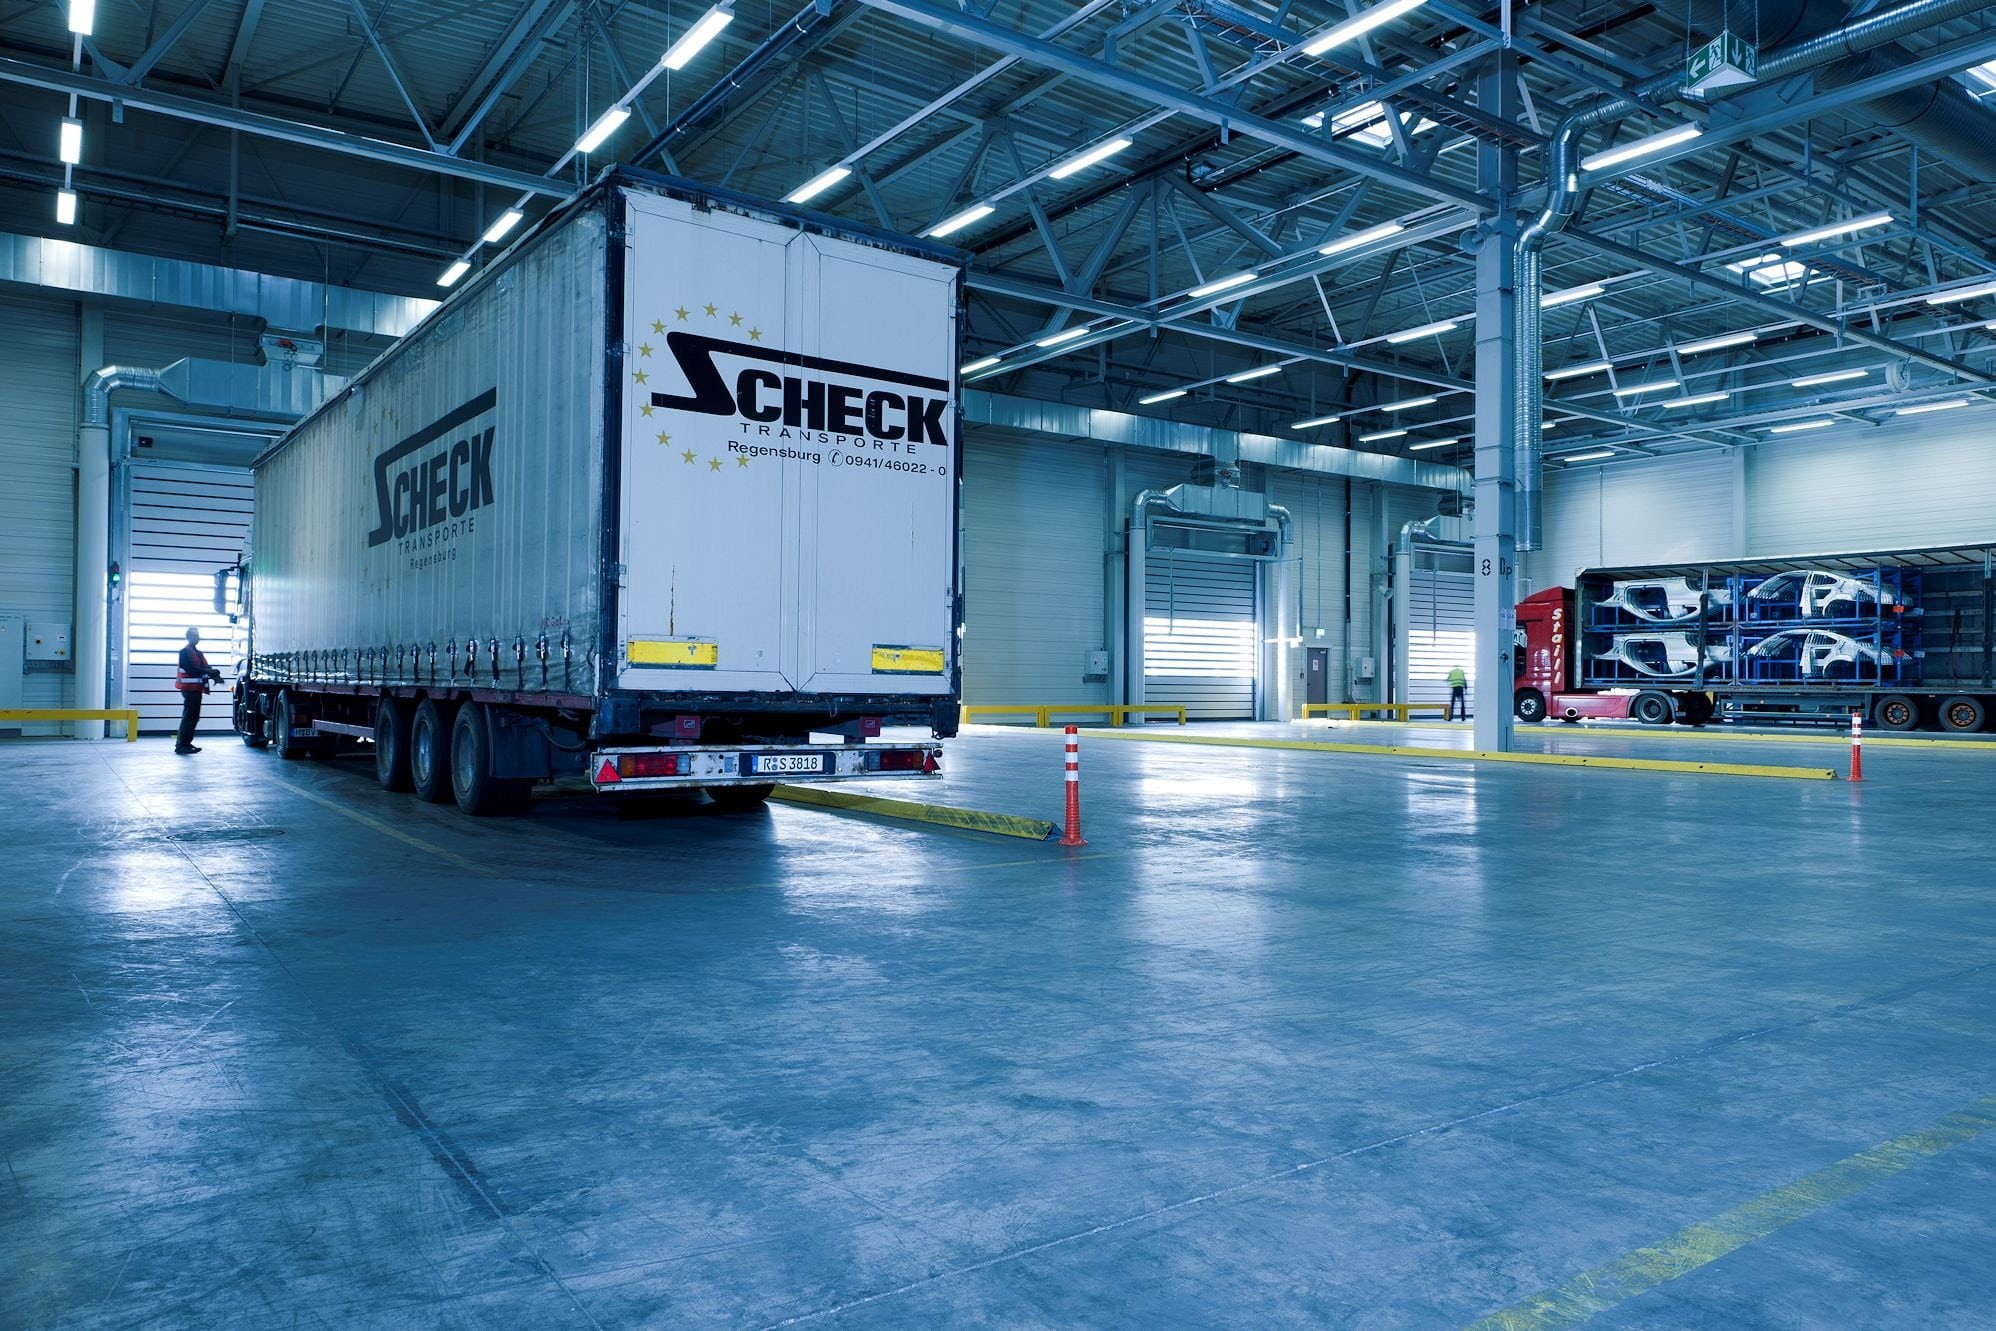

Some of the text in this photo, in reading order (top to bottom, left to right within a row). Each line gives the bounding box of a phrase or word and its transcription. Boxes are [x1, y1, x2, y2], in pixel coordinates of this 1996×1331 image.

[651, 331, 949, 446] SCHECK
[739, 422, 917, 455] TRANSPORTE
[368, 386, 497, 548] SCHECK
[728, 440, 821, 465] Regensburg
[845, 455, 927, 474] 0941/46022
[398, 517, 475, 556] TRANSPORTE
[410, 548, 457, 571] Regensburg
[1481, 558, 1491, 576] 8
